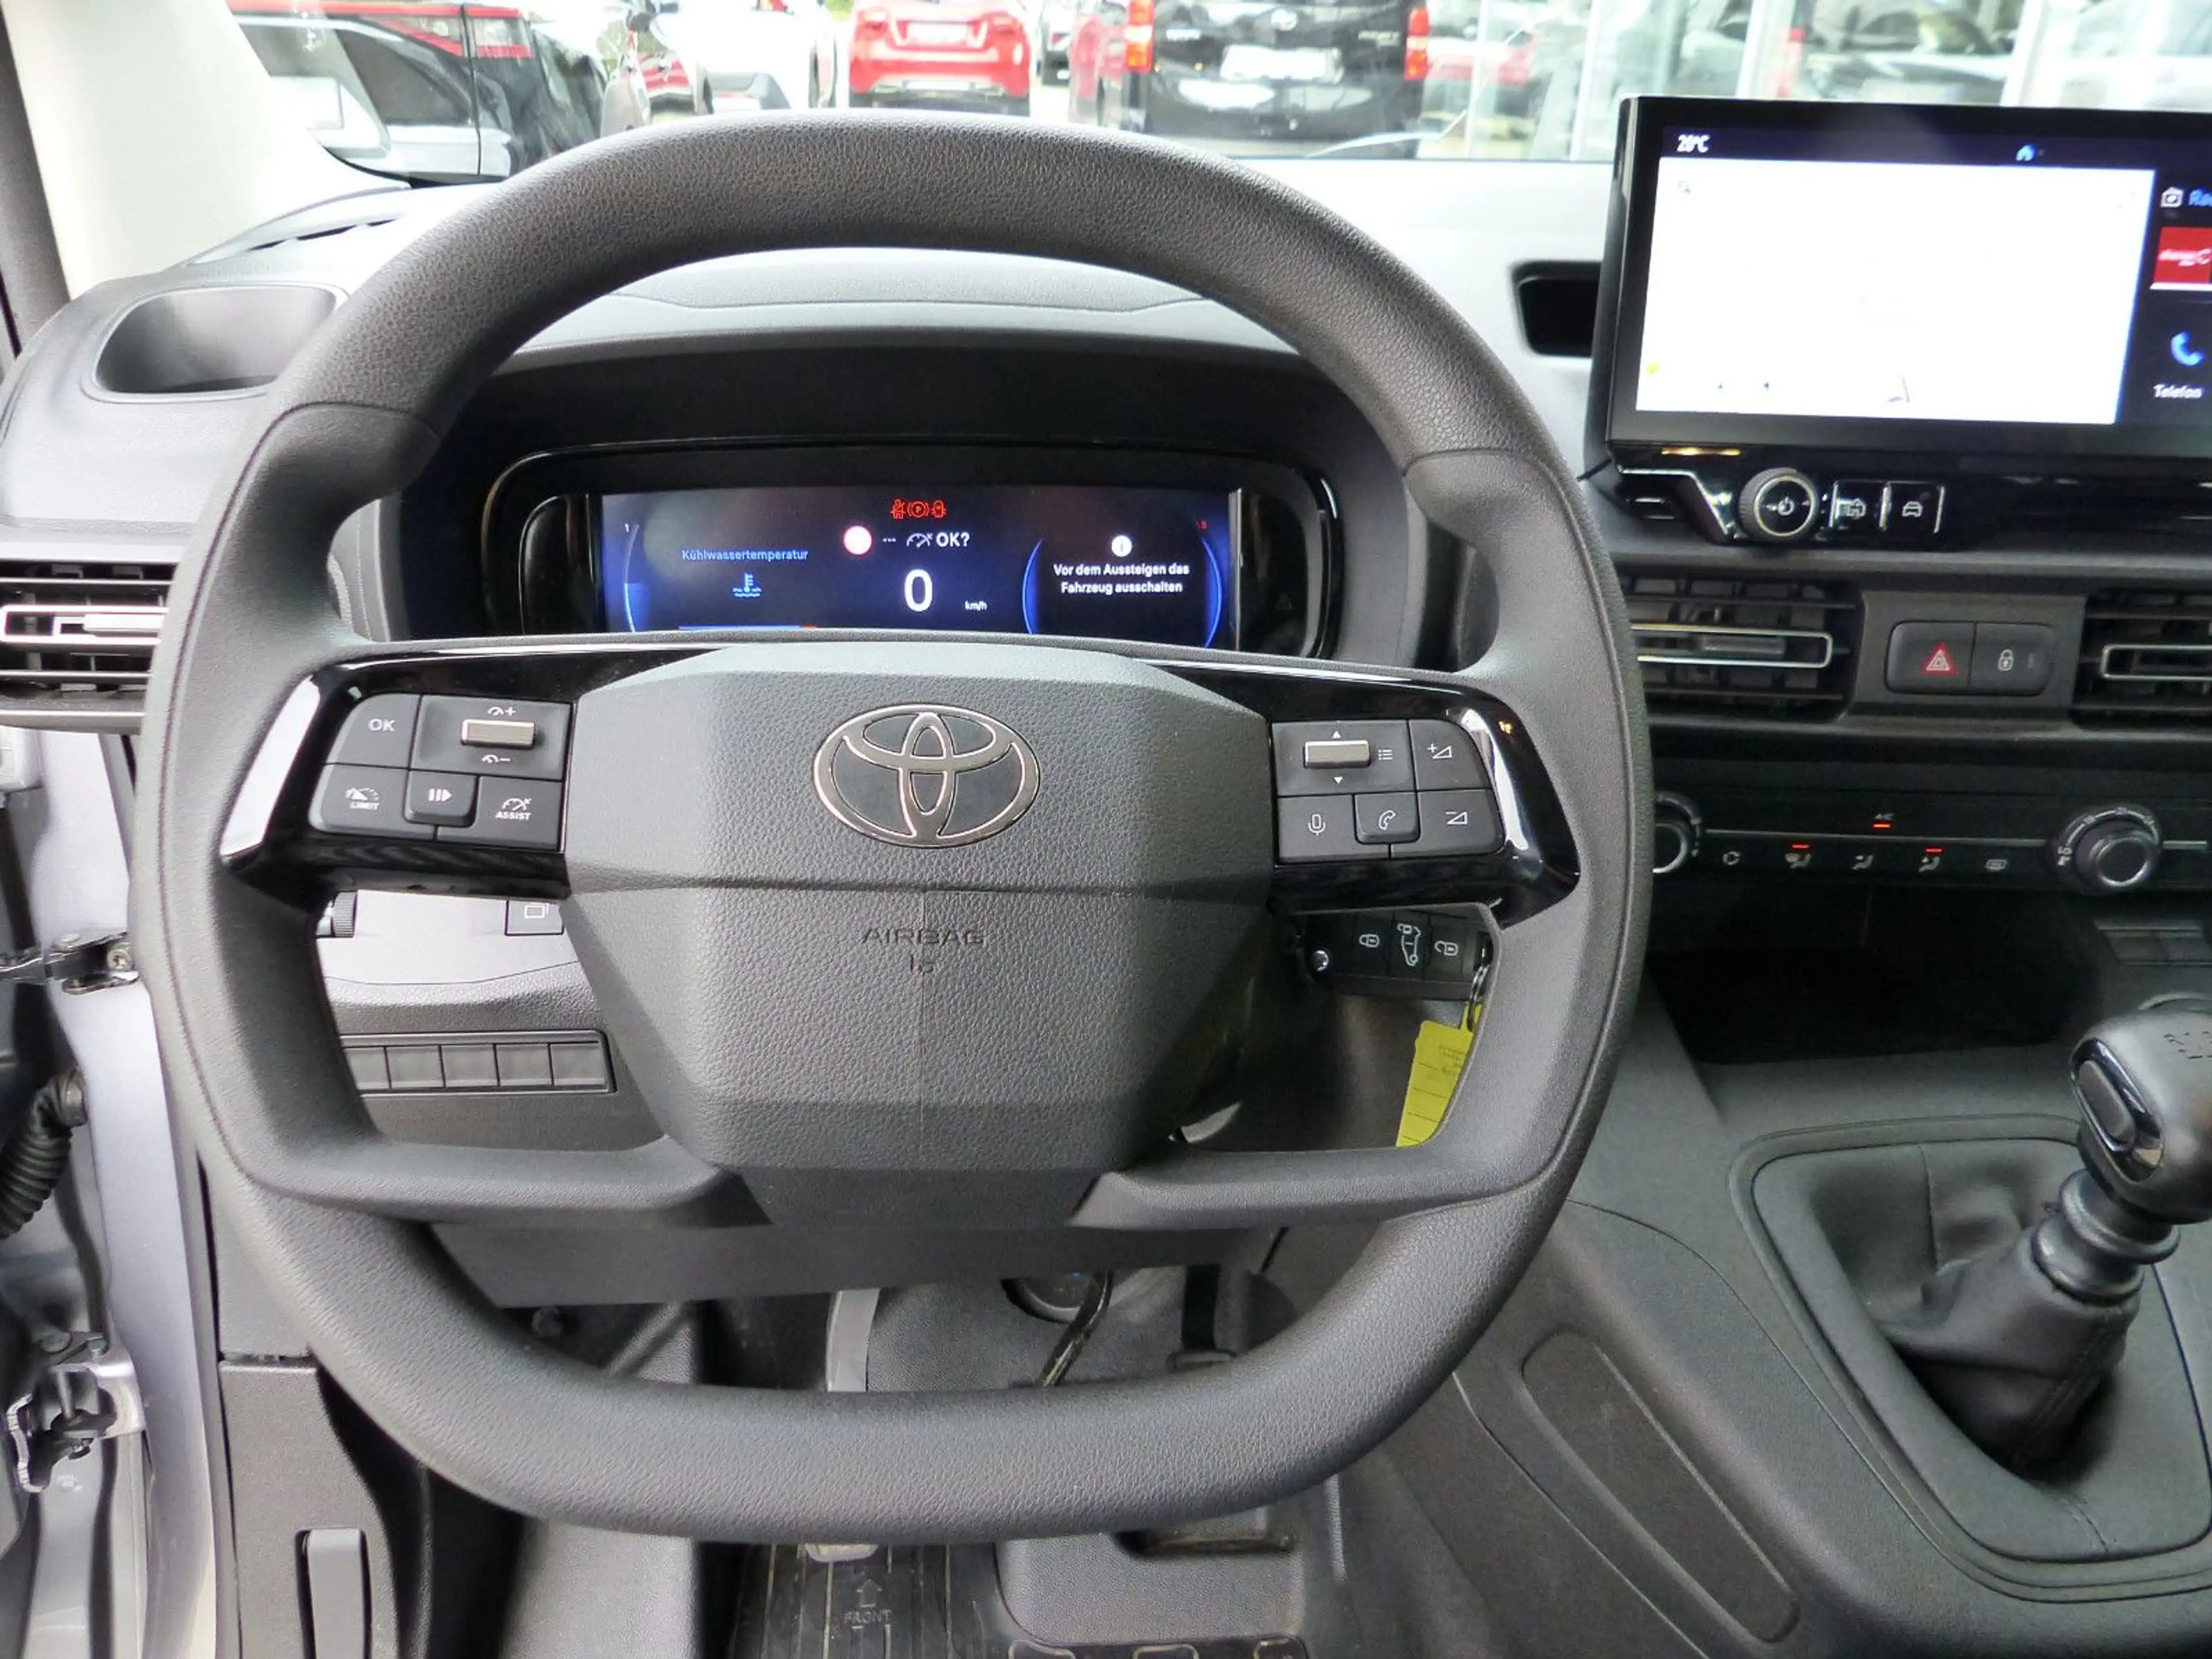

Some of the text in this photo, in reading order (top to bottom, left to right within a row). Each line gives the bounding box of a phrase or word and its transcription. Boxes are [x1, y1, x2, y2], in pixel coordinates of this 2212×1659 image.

[2153, 384, 2202, 399] Telefon
[935, 532, 970, 547] OK?
[681, 549, 808, 562] Kühlwassertemperatur
[1053, 562, 1191, 578] Vor dem Aussteigen das
[904, 569, 933, 612] 0
[1060, 580, 1183, 596] Fahrzeug ausschalten
[964, 600, 988, 611] km/h
[368, 718, 396, 732] OK
[349, 801, 380, 810] LIMIT
[496, 811, 532, 820] ASSIST
[863, 928, 984, 947] AIRBAG
[843, 1609, 892, 1624] FRONT
